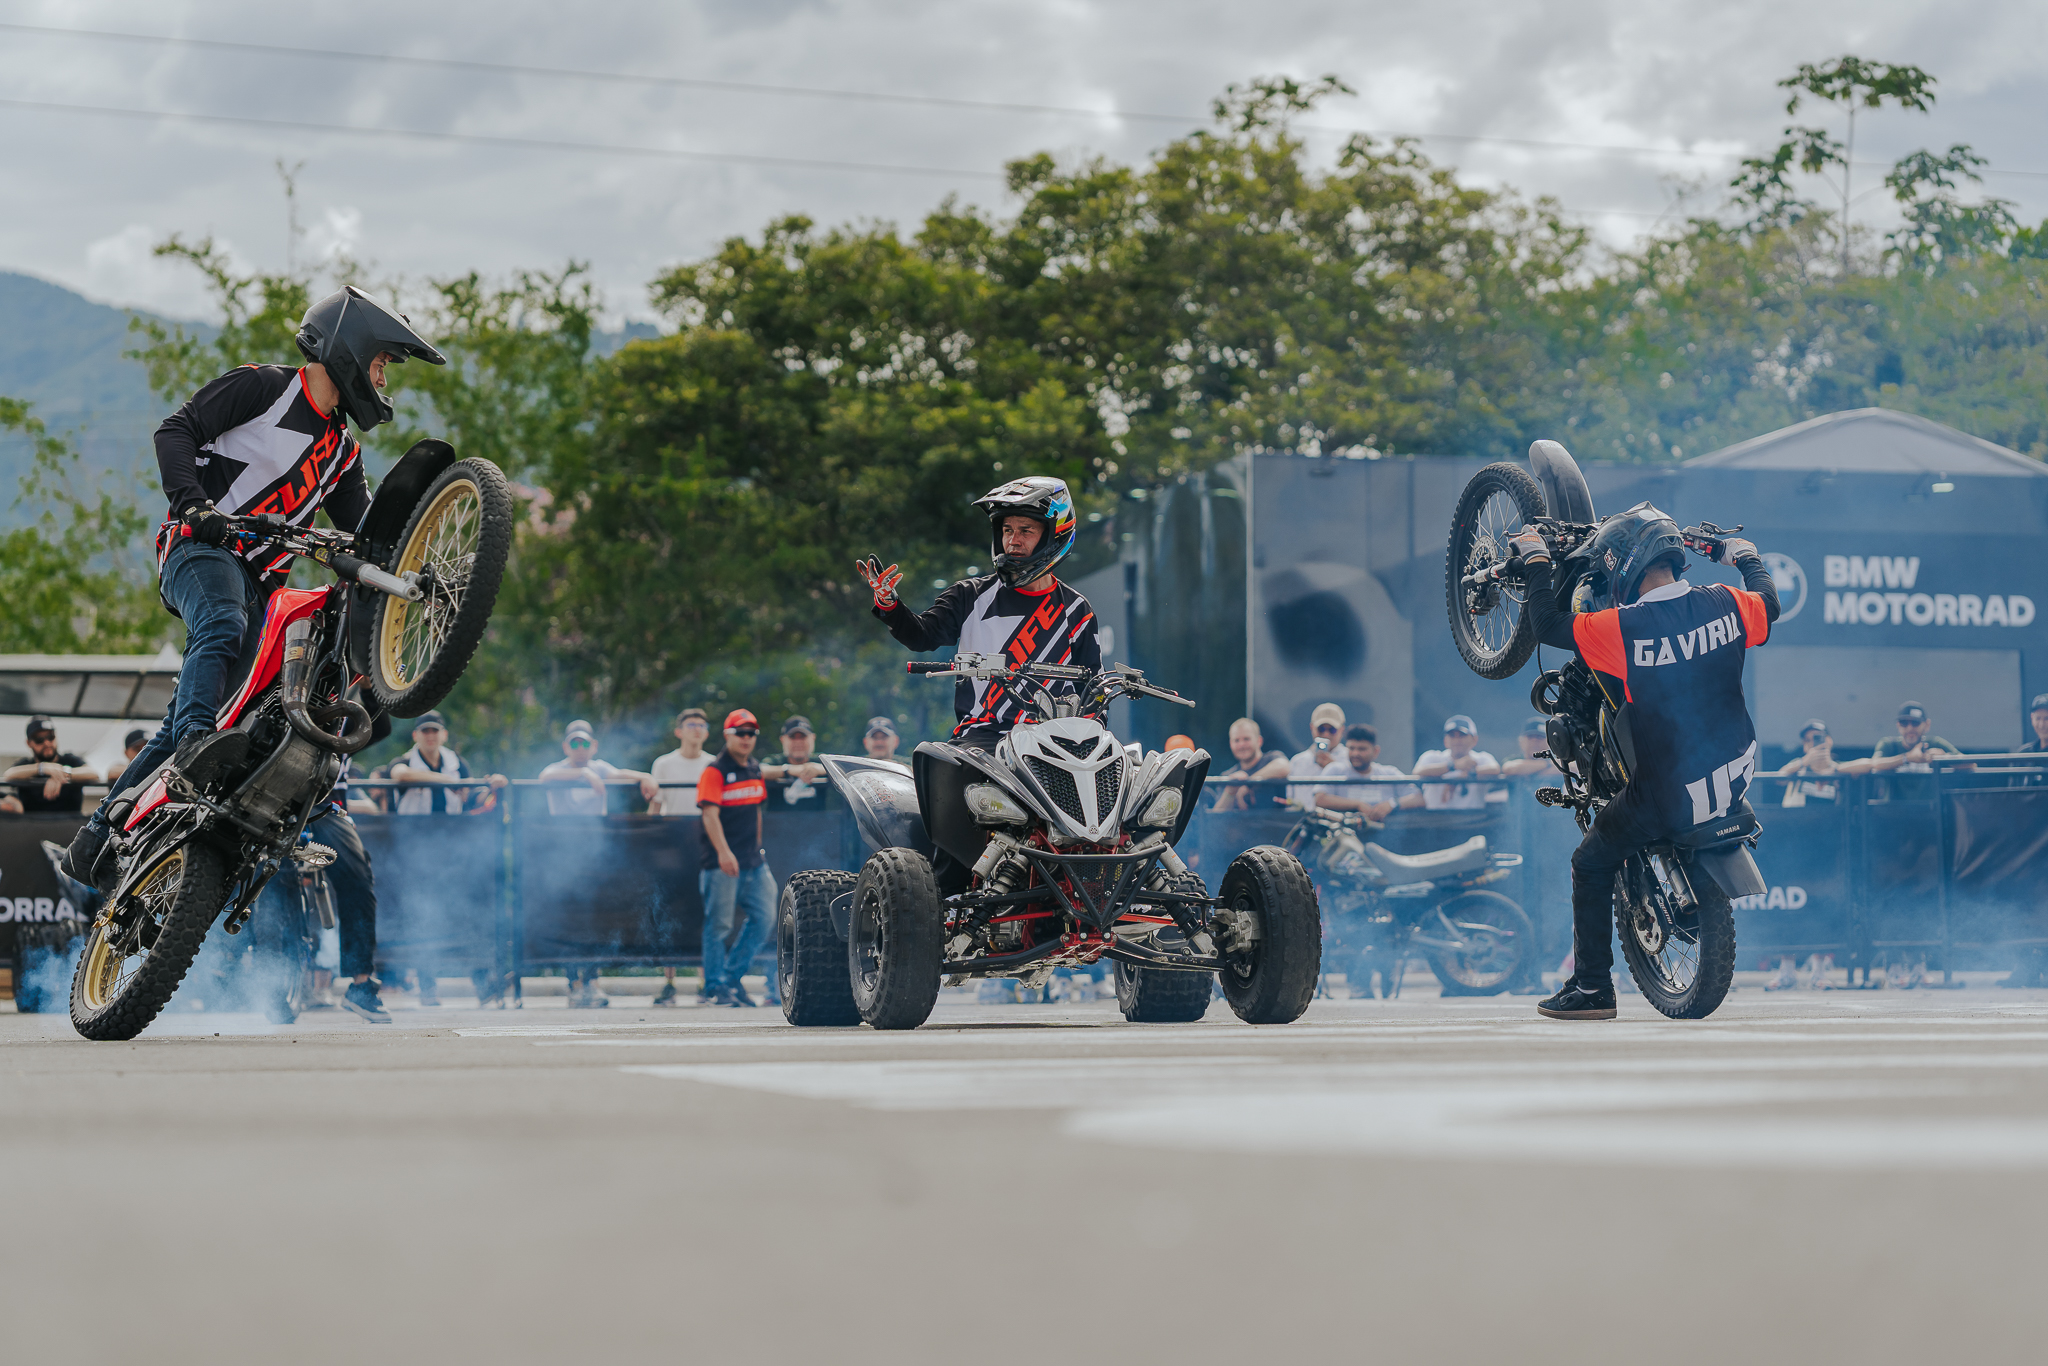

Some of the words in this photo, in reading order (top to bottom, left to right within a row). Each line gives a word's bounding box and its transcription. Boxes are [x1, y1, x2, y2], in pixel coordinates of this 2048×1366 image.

[1824, 555, 1920, 588] BMW
[1824, 592, 2036, 627] MOTORRAD
[1716, 824, 1740, 837] YAMAHA
